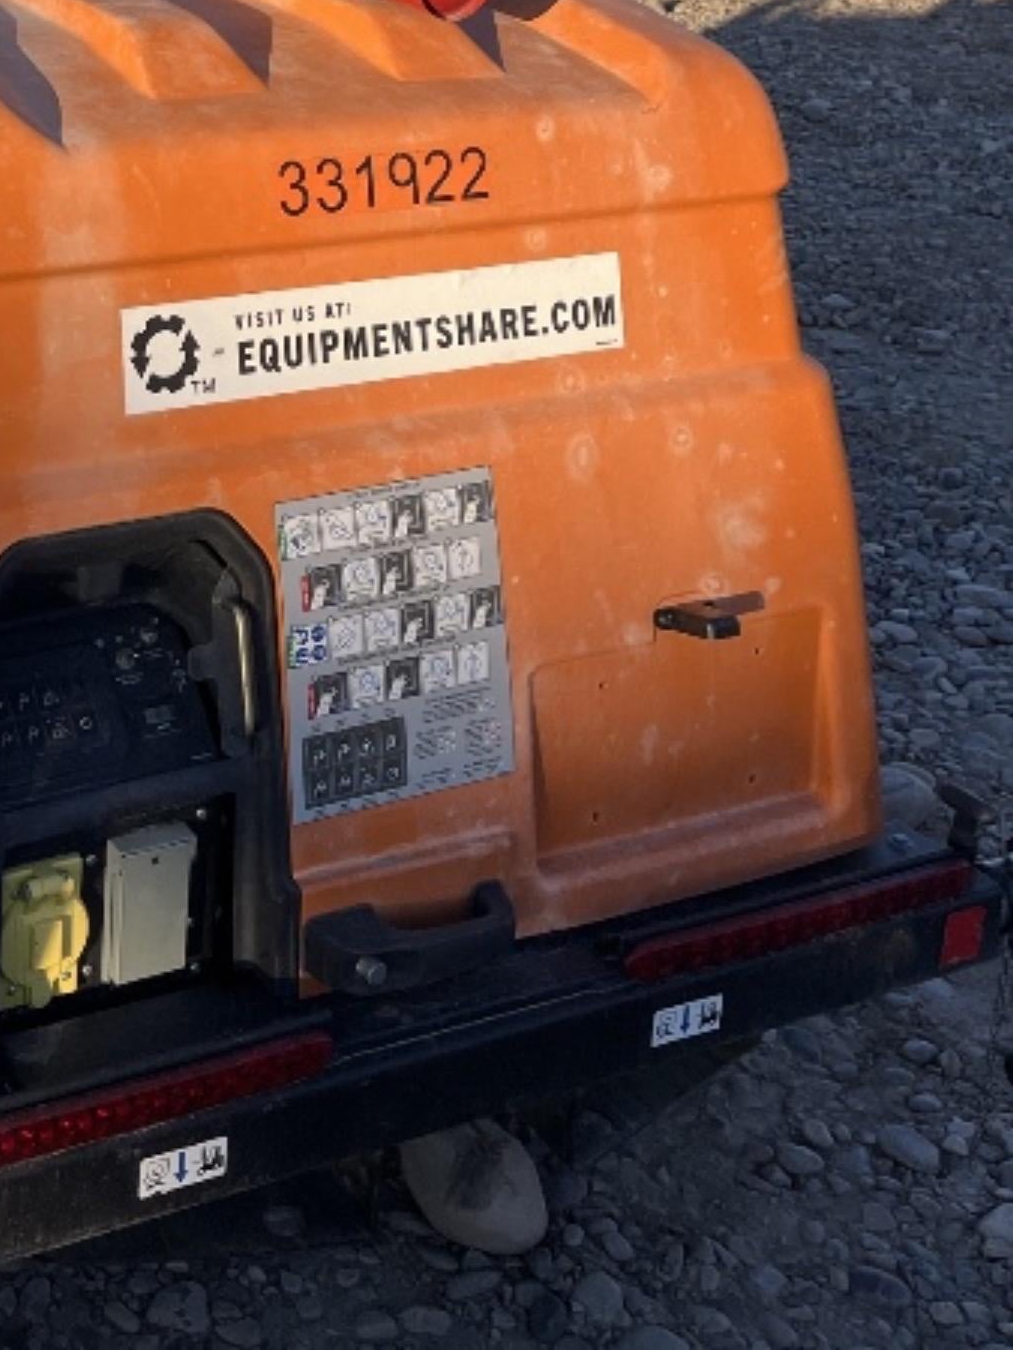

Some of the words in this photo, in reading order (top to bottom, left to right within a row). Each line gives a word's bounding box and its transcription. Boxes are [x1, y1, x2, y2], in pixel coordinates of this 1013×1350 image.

[278, 146, 490, 217] 331922
[234, 308, 285, 330] VISIT
[292, 305, 316, 322] US
[237, 293, 617, 376] EQUIPMENTSHARE.COM
